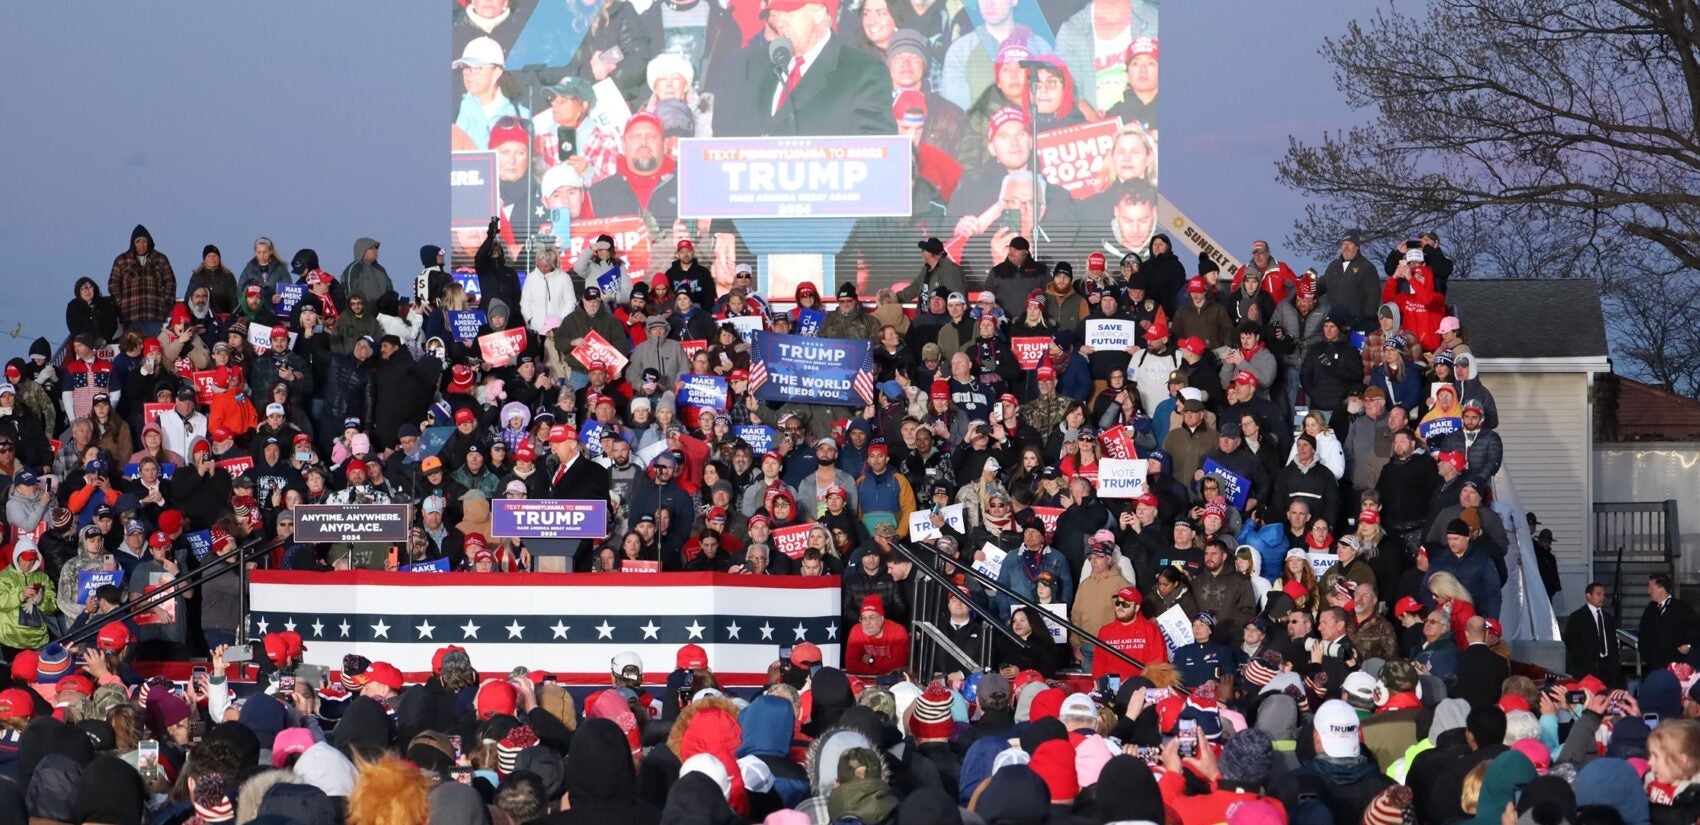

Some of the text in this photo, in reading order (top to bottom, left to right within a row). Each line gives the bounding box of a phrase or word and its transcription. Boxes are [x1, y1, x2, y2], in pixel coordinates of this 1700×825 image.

[1037, 135, 1113, 166] RUMP
[721, 161, 868, 191] TRUMP
[1184, 226, 1230, 267] SUNBELT
[281, 292, 303, 300] AMERIC
[779, 343, 846, 362] TRUMP
[1016, 343, 1050, 352] TRUM
[1022, 352, 1043, 360] 202
[691, 377, 715, 385] MAKE
[770, 372, 851, 390] THE WORLD
[688, 390, 715, 398] GREAT
[780, 386, 840, 398] NEEDS YOU
[687, 397, 716, 405] AGAIN!
[1113, 437, 1127, 460] 024
[1111, 469, 1136, 477] VOTE
[1214, 467, 1238, 484] MAKE
[1102, 479, 1142, 489] TRUMP
[301, 513, 401, 522] ANYTIME. ANYWHERE.
[513, 511, 585, 525] TRUMP
[319, 523, 383, 532] ANYPLACE.
[773, 530, 810, 545] TRUM
[778, 540, 808, 553] 2024
[92, 574, 113, 582] MAKE
